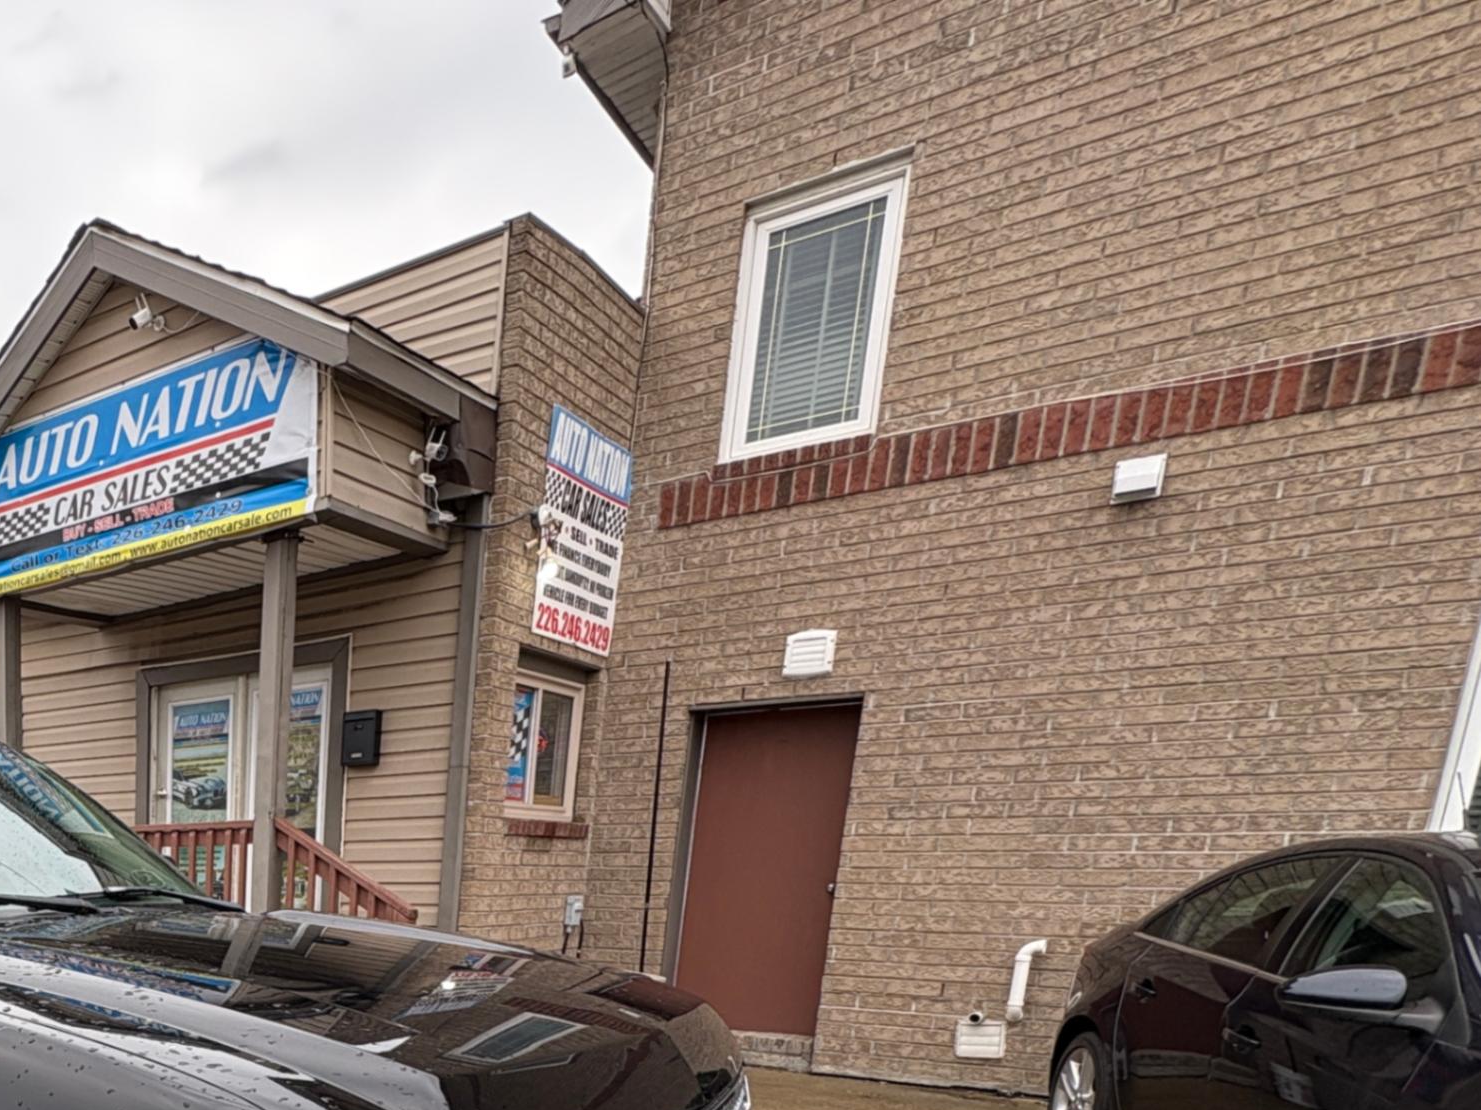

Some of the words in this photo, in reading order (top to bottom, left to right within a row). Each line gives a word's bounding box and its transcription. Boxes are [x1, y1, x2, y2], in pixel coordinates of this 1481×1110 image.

[110, 352, 288, 456] NATION
[550, 411, 589, 475] AUTO
[584, 432, 631, 499] NATION
[53, 488, 95, 527] CAR
[101, 464, 171, 513] SALES
[62, 522, 88, 542] BUY
[93, 513, 124, 534] SELL
[131, 496, 175, 521] TRADE
[560, 479, 584, 520] CAR
[579, 490, 611, 533] SALES
[130, 505, 293, 557] www.autonationcarsale.com
[570, 525, 587, 547] SELL
[594, 537, 618, 561] TRADE
[11, 554, 39, 573] Call
[44, 551, 60, 563] or
[535, 602, 611, 652] 226.246.2429
